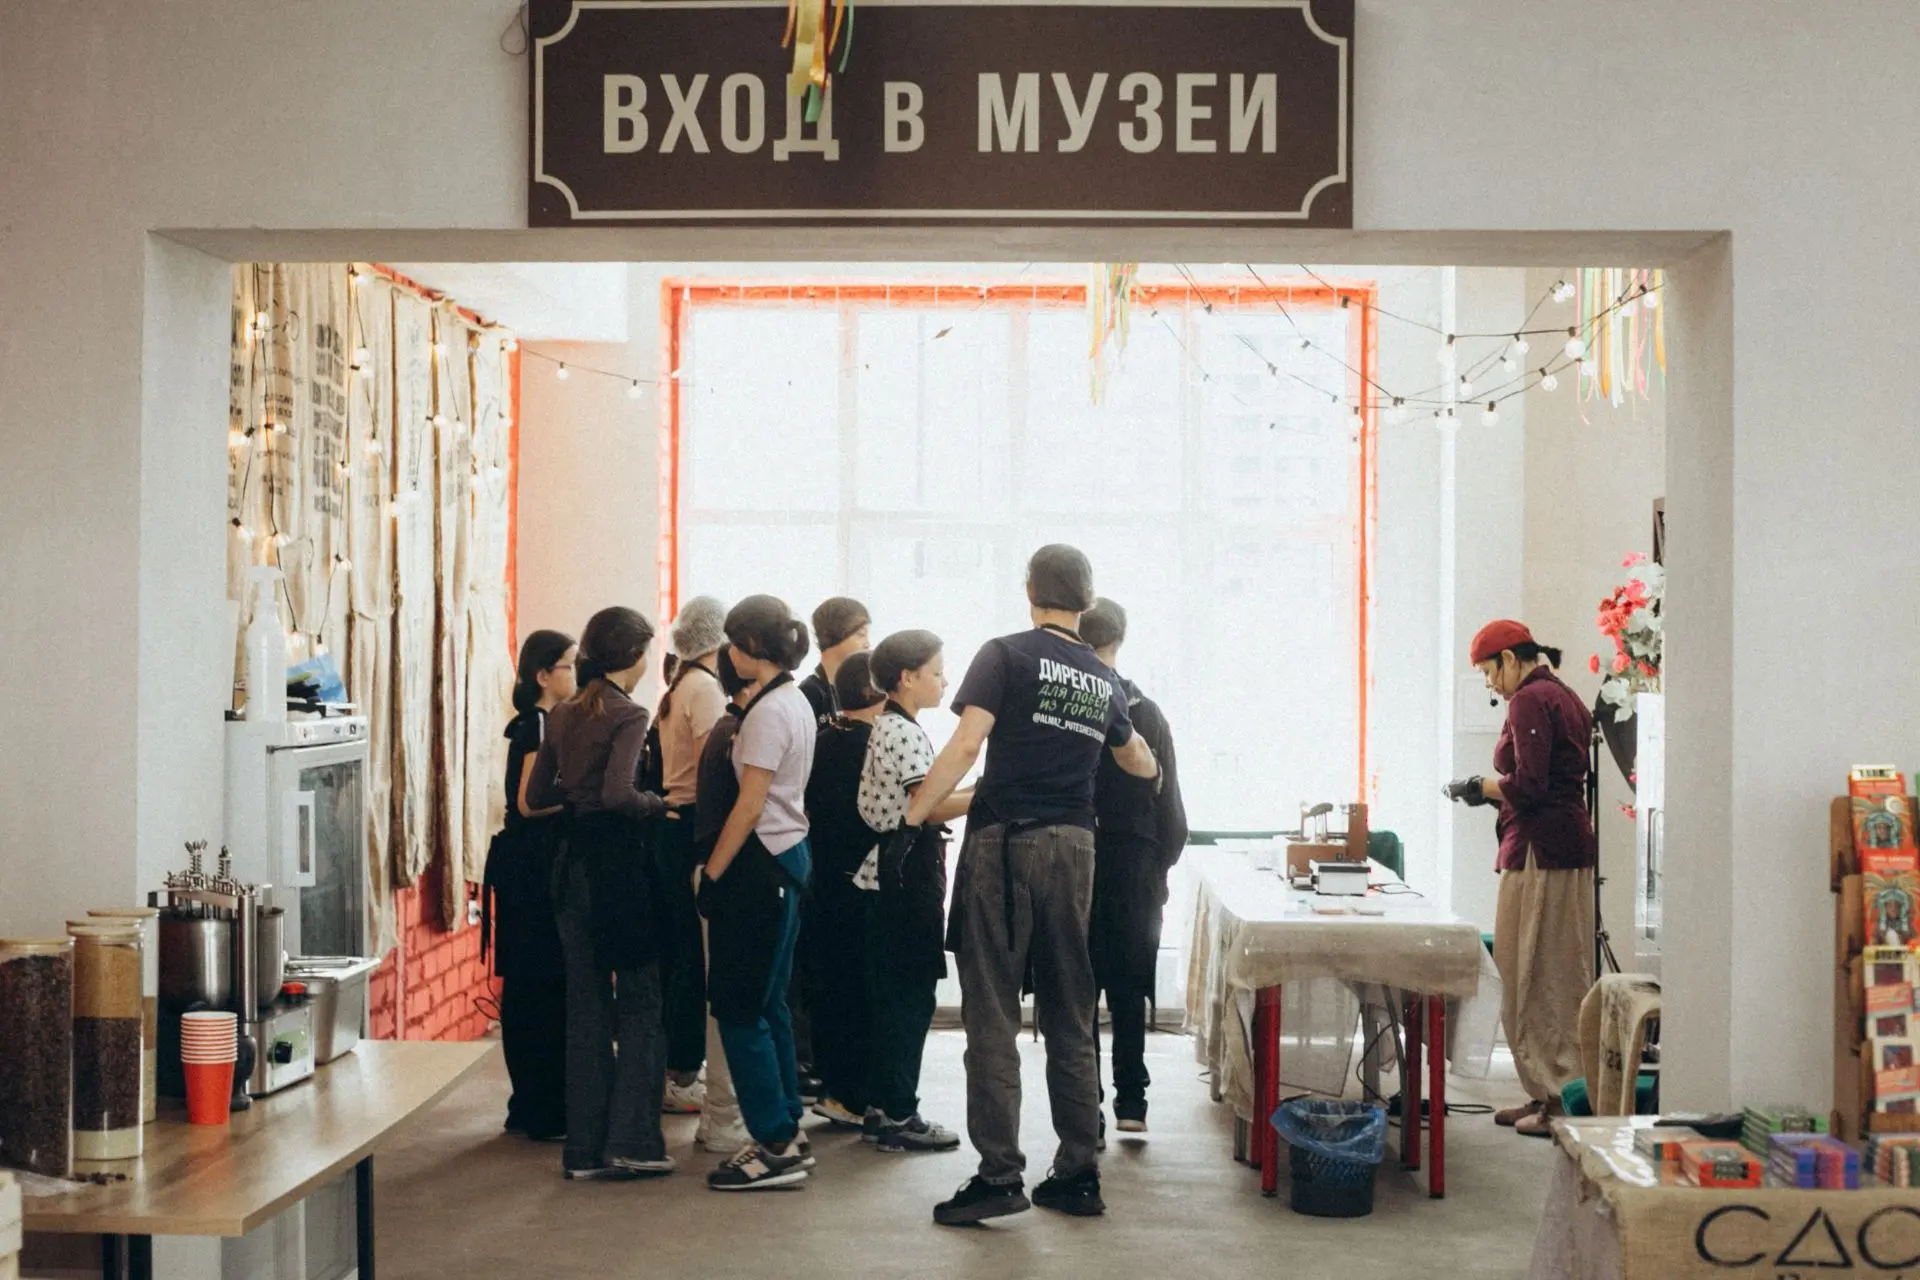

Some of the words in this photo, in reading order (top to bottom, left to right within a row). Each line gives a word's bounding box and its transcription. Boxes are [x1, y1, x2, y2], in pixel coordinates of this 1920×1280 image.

[604, 72, 840, 161] ВХОД
[1038, 684, 1068, 700] ДЛЯ
[1039, 658, 1113, 701] ДИРЕКТОР
[1039, 699, 1057, 712] ИЗ
[1062, 701, 1105, 724] ГОРОДА
